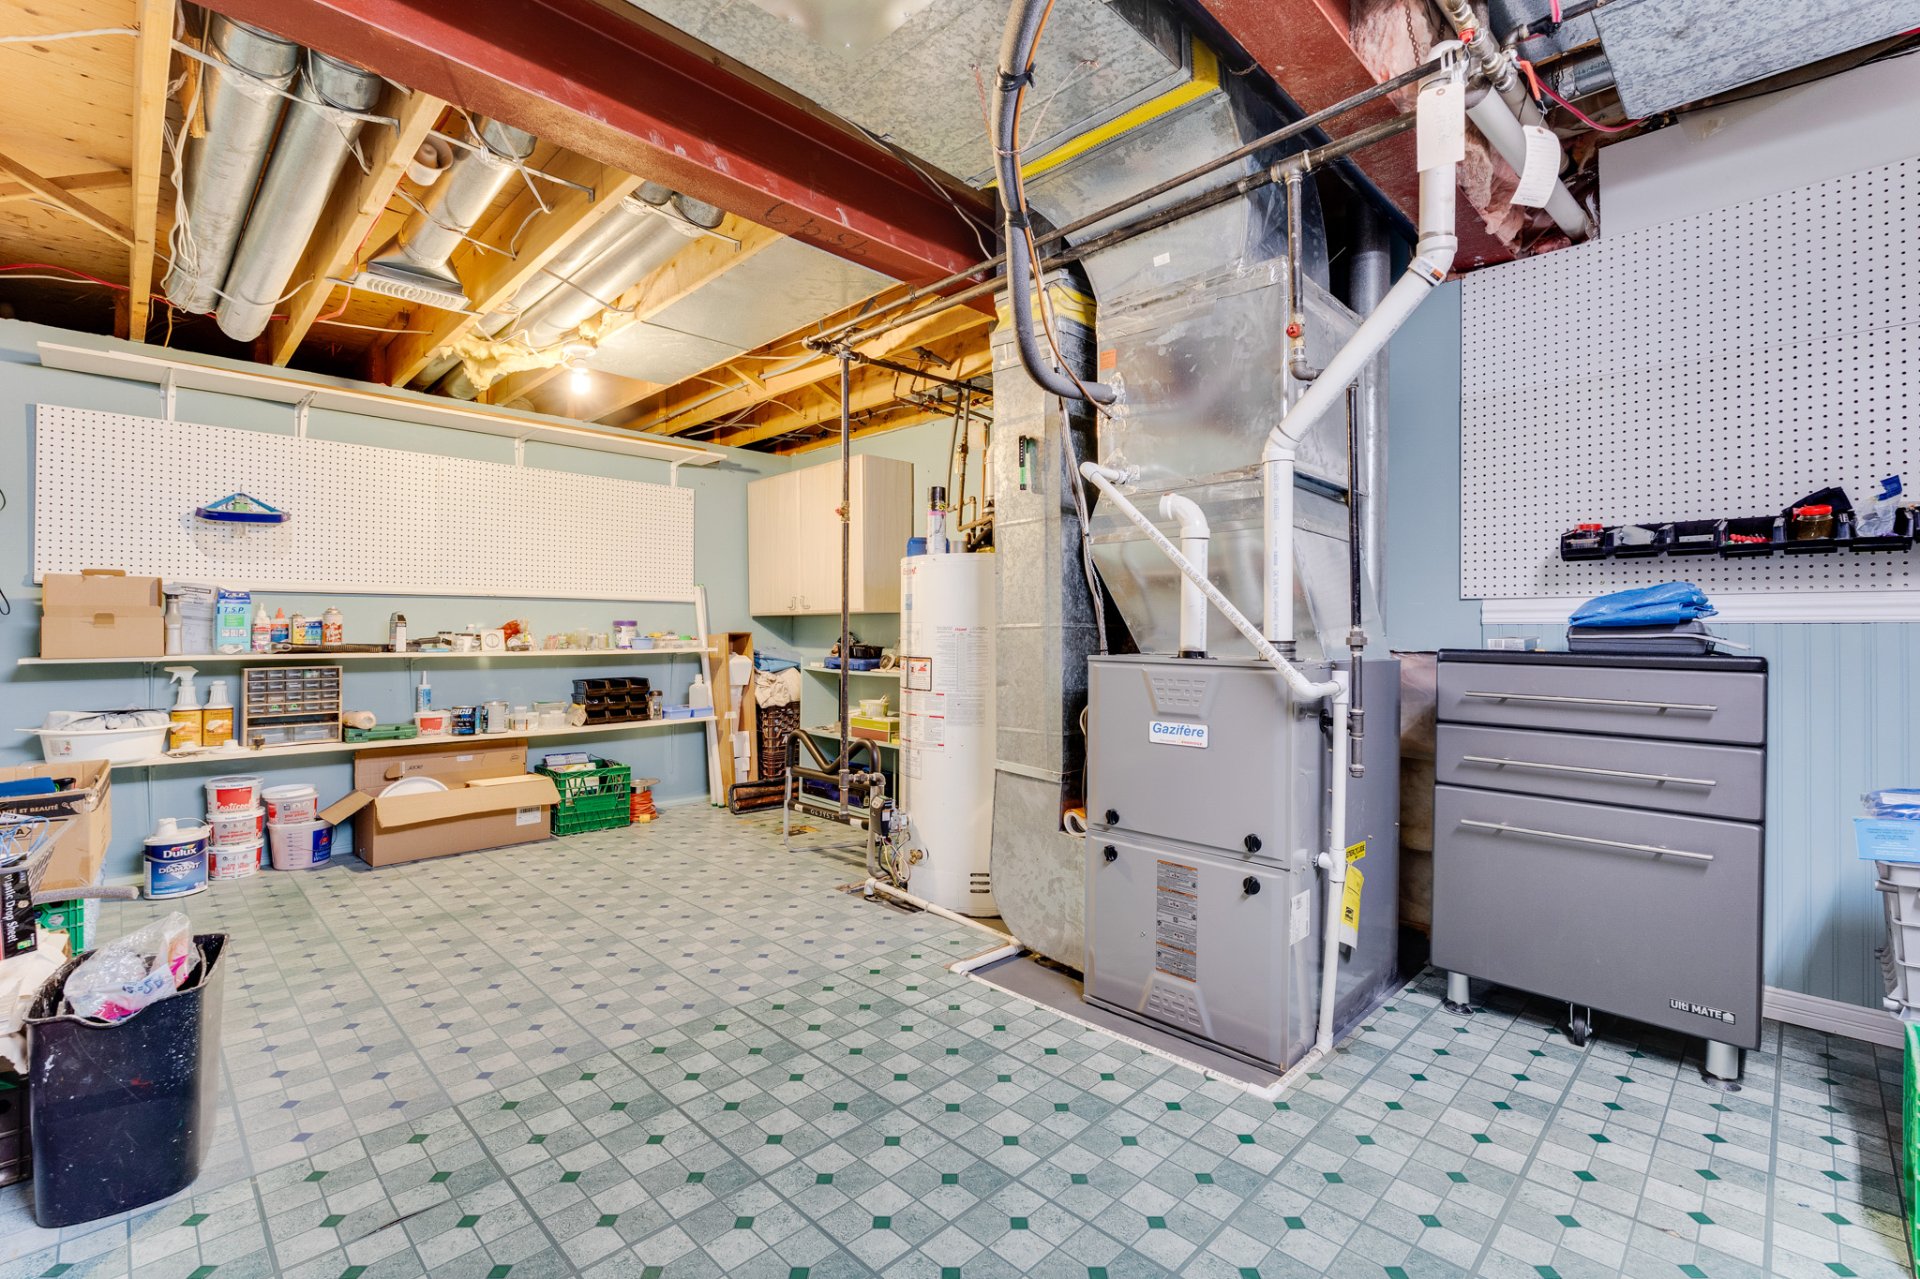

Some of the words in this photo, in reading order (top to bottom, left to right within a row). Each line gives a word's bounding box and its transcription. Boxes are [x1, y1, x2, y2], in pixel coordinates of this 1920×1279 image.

[1152, 722, 1205, 738] Gazifère
[30, 803, 59, 813] BEAUTÉ
[163, 847, 197, 859] Dulux
[3, 873, 16, 900] Plastic
[2, 900, 15, 920] Drop
[6, 920, 19, 943] Sheet
[1691, 1004, 1722, 1020] MATE
